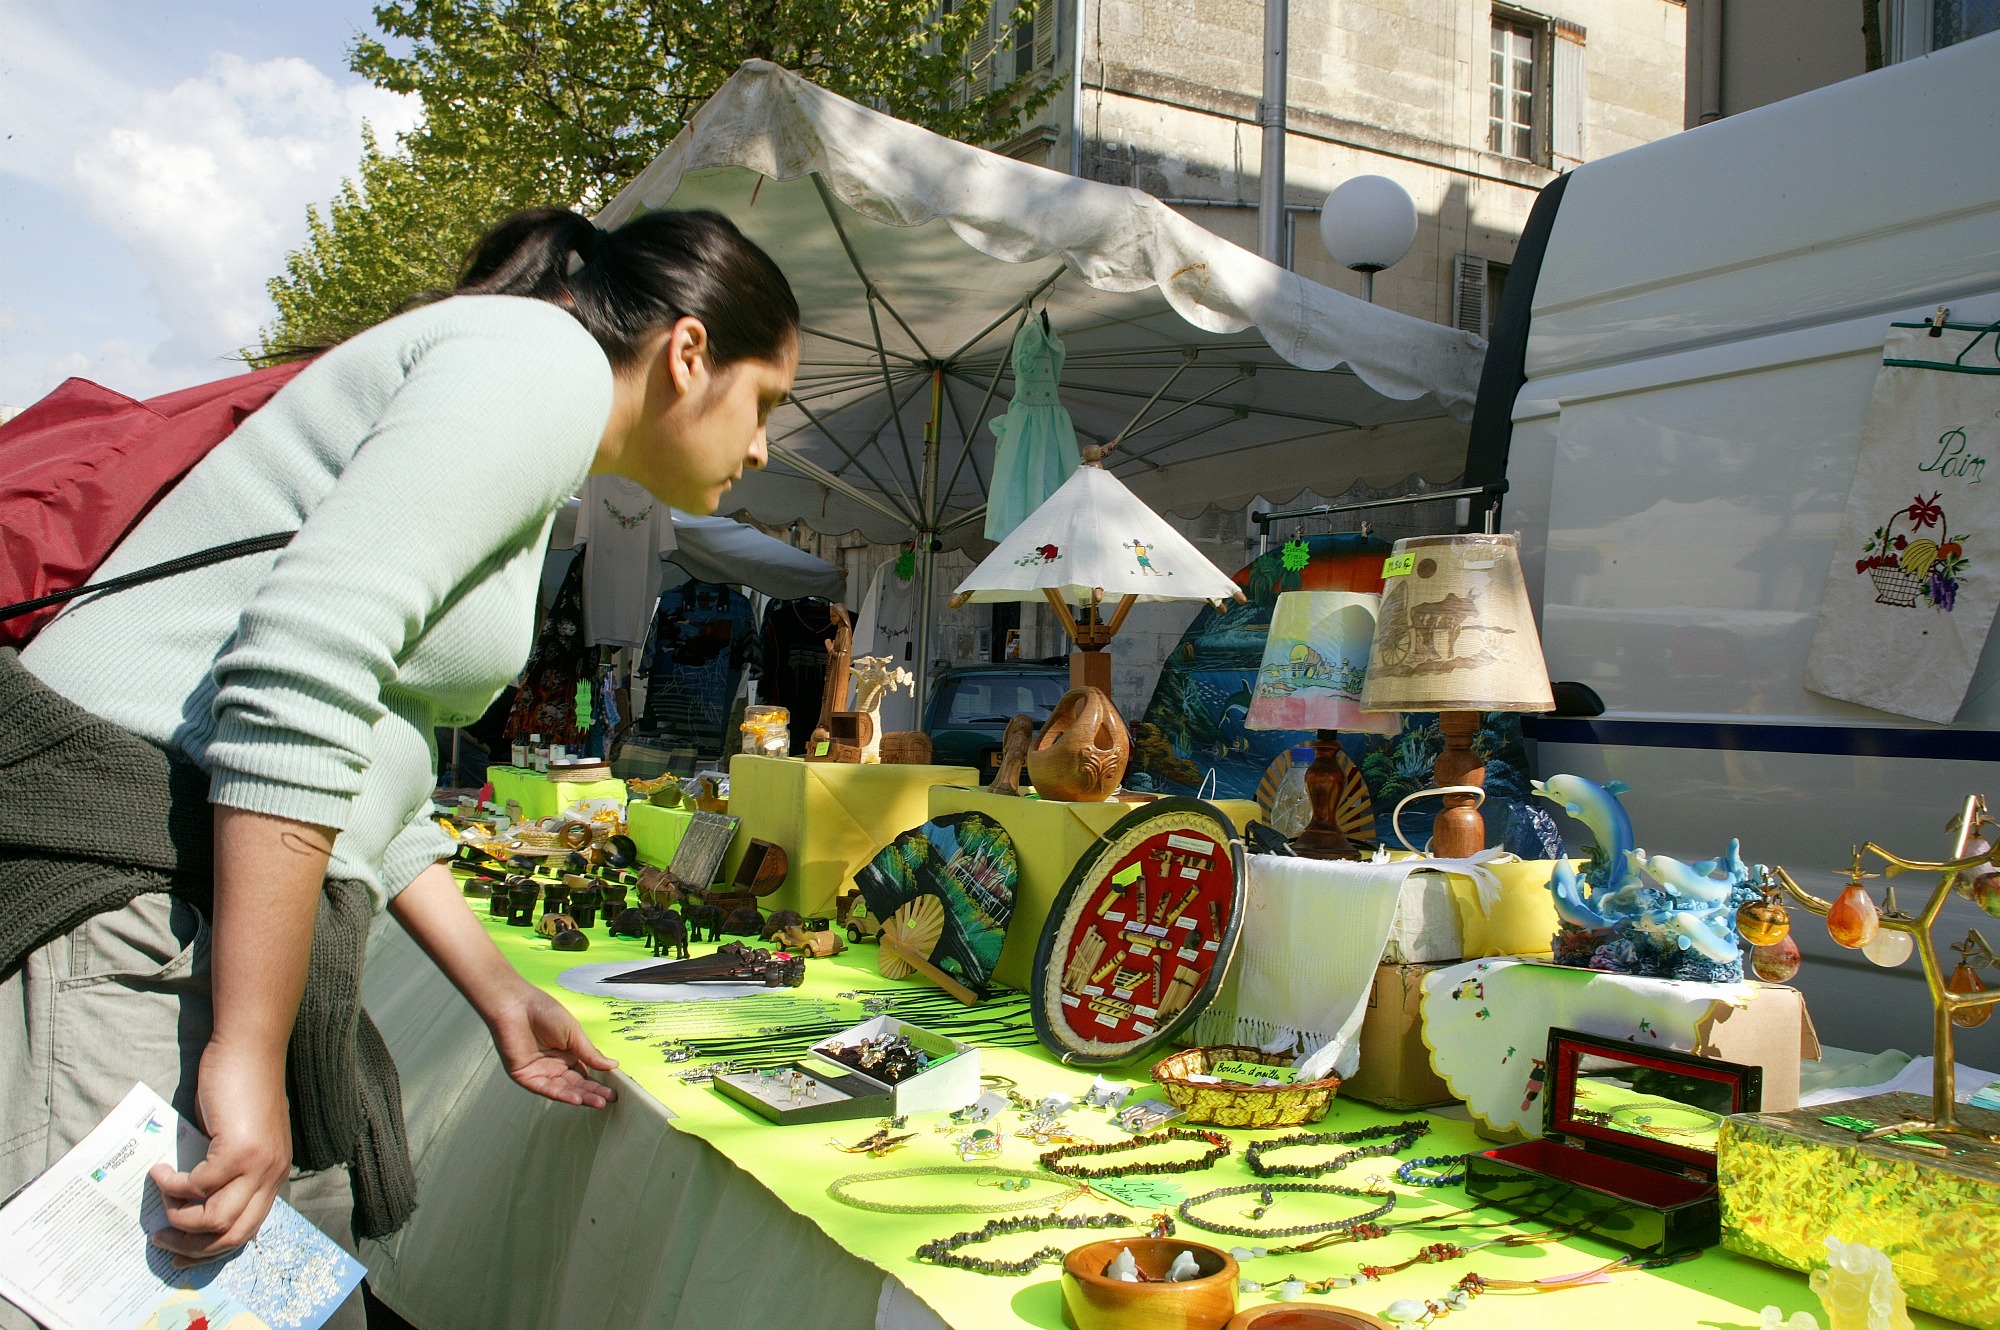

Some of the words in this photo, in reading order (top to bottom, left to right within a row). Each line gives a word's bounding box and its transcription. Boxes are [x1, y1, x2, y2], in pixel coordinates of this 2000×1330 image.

[1919, 426, 1986, 484] Pain
[101, 1137, 138, 1172] Charentes
[110, 1147, 135, 1171] Poitou
